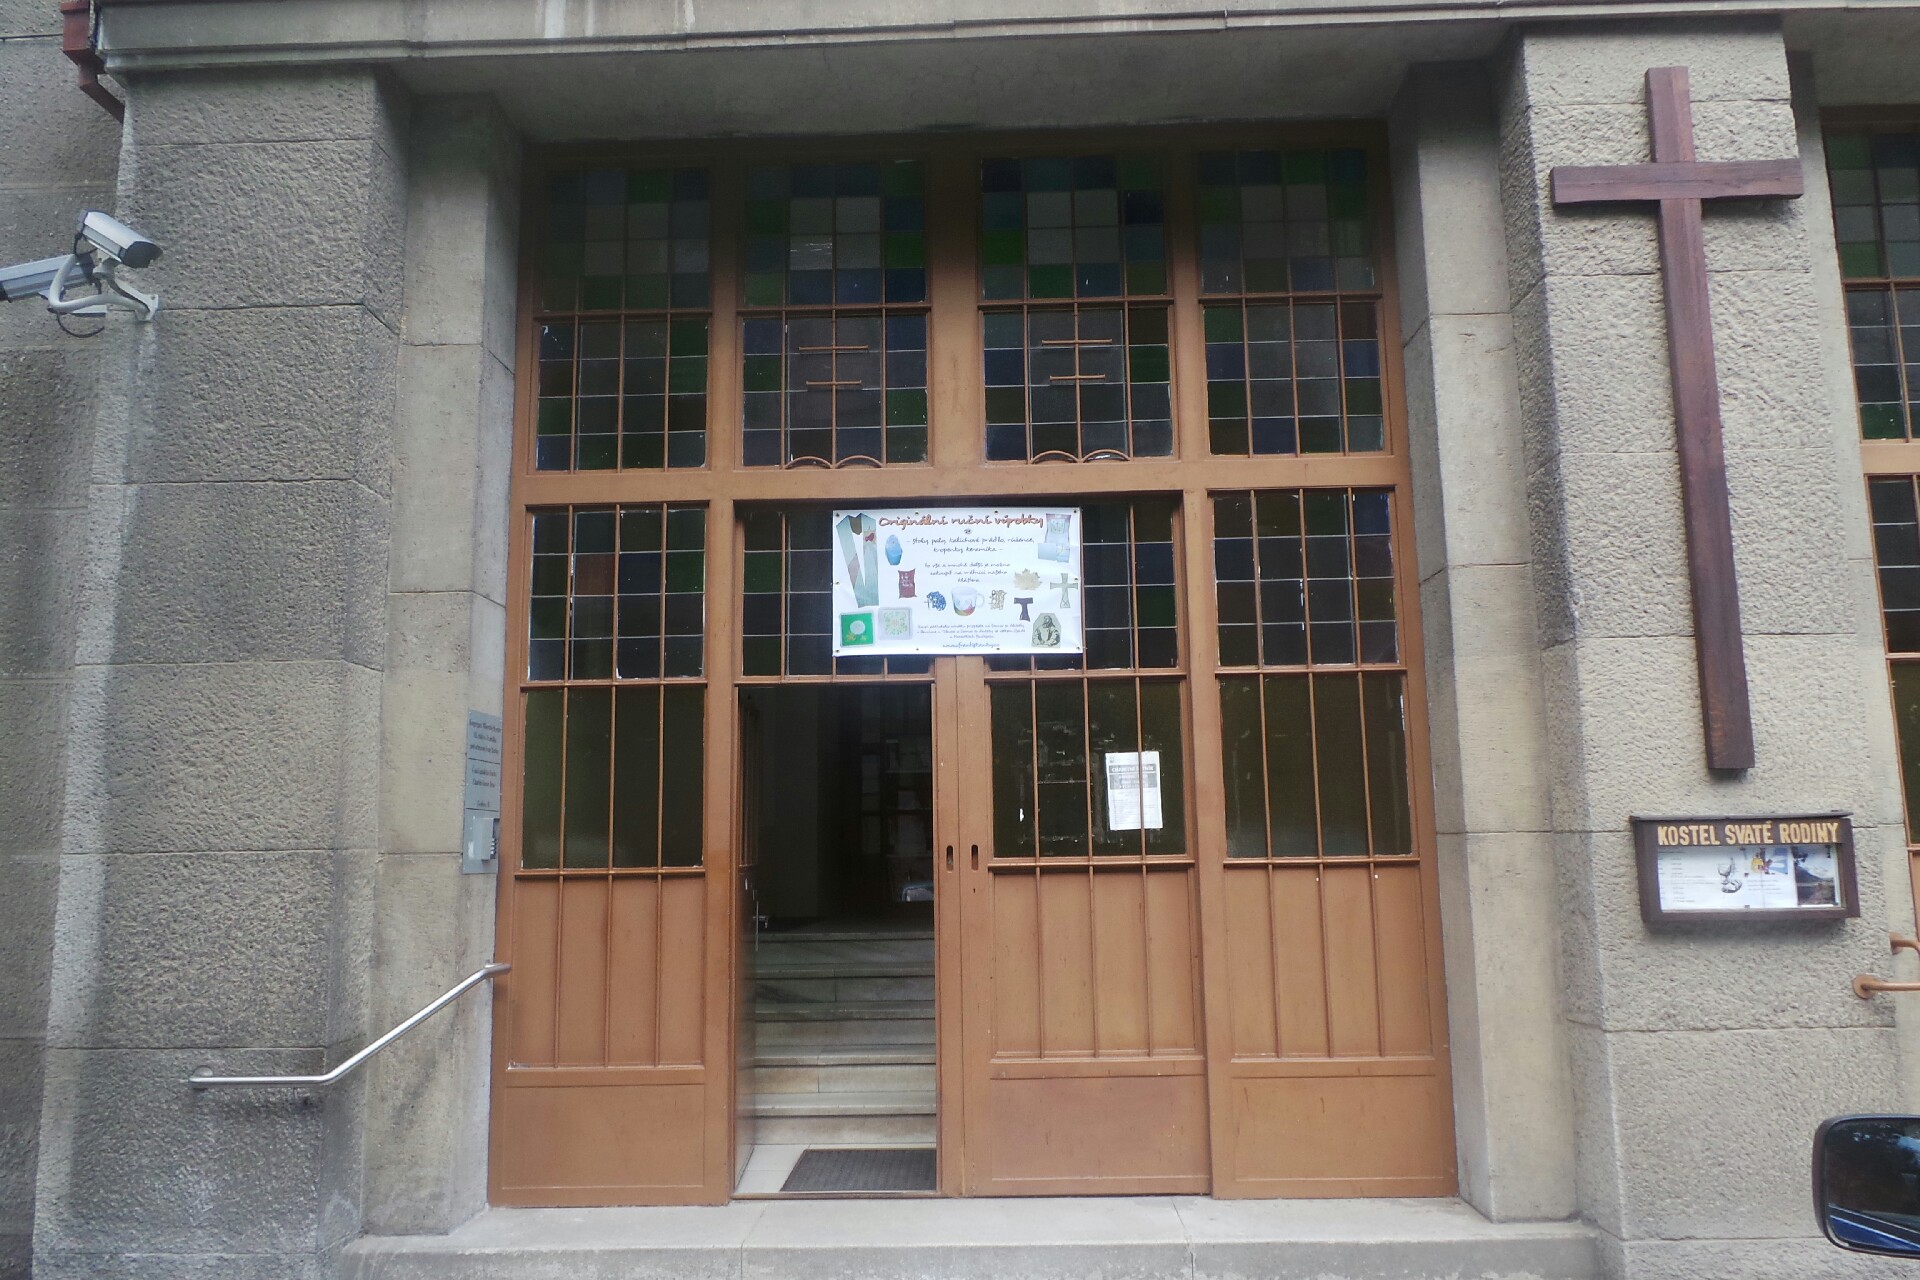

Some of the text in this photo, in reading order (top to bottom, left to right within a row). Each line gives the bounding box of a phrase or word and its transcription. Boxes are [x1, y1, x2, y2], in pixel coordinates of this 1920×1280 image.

[879, 513, 1044, 530] Originální ruční výrobky
[1658, 821, 1839, 845] KOSTEL SVATÉ RODINY
